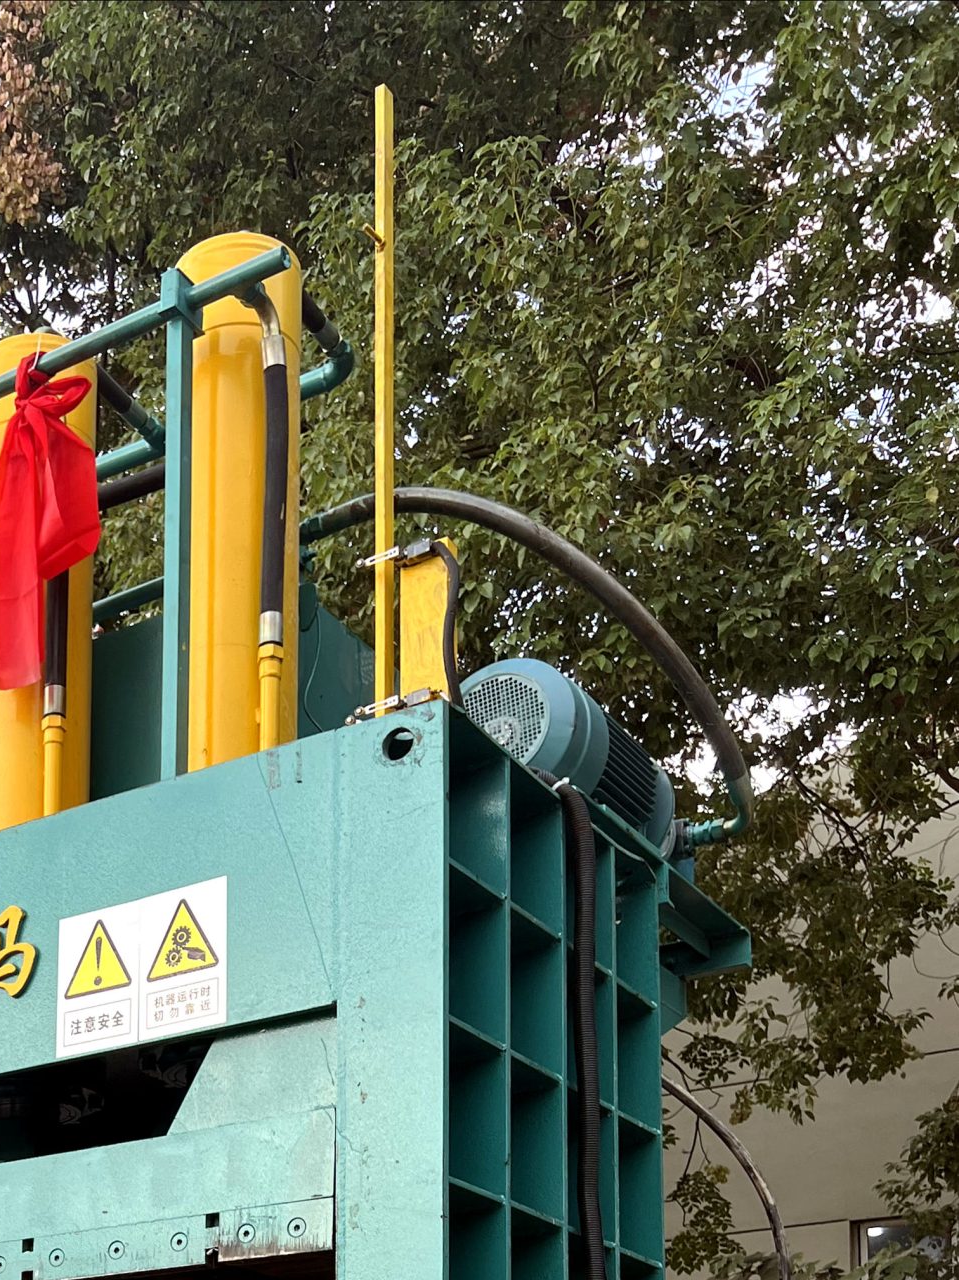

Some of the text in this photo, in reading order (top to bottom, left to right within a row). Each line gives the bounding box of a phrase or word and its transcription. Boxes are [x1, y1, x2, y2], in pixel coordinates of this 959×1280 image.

[154, 985, 211, 1008] 机器运行时
[154, 1000, 211, 1022] 切勿靠近
[70, 1010, 124, 1036] 注意安全
